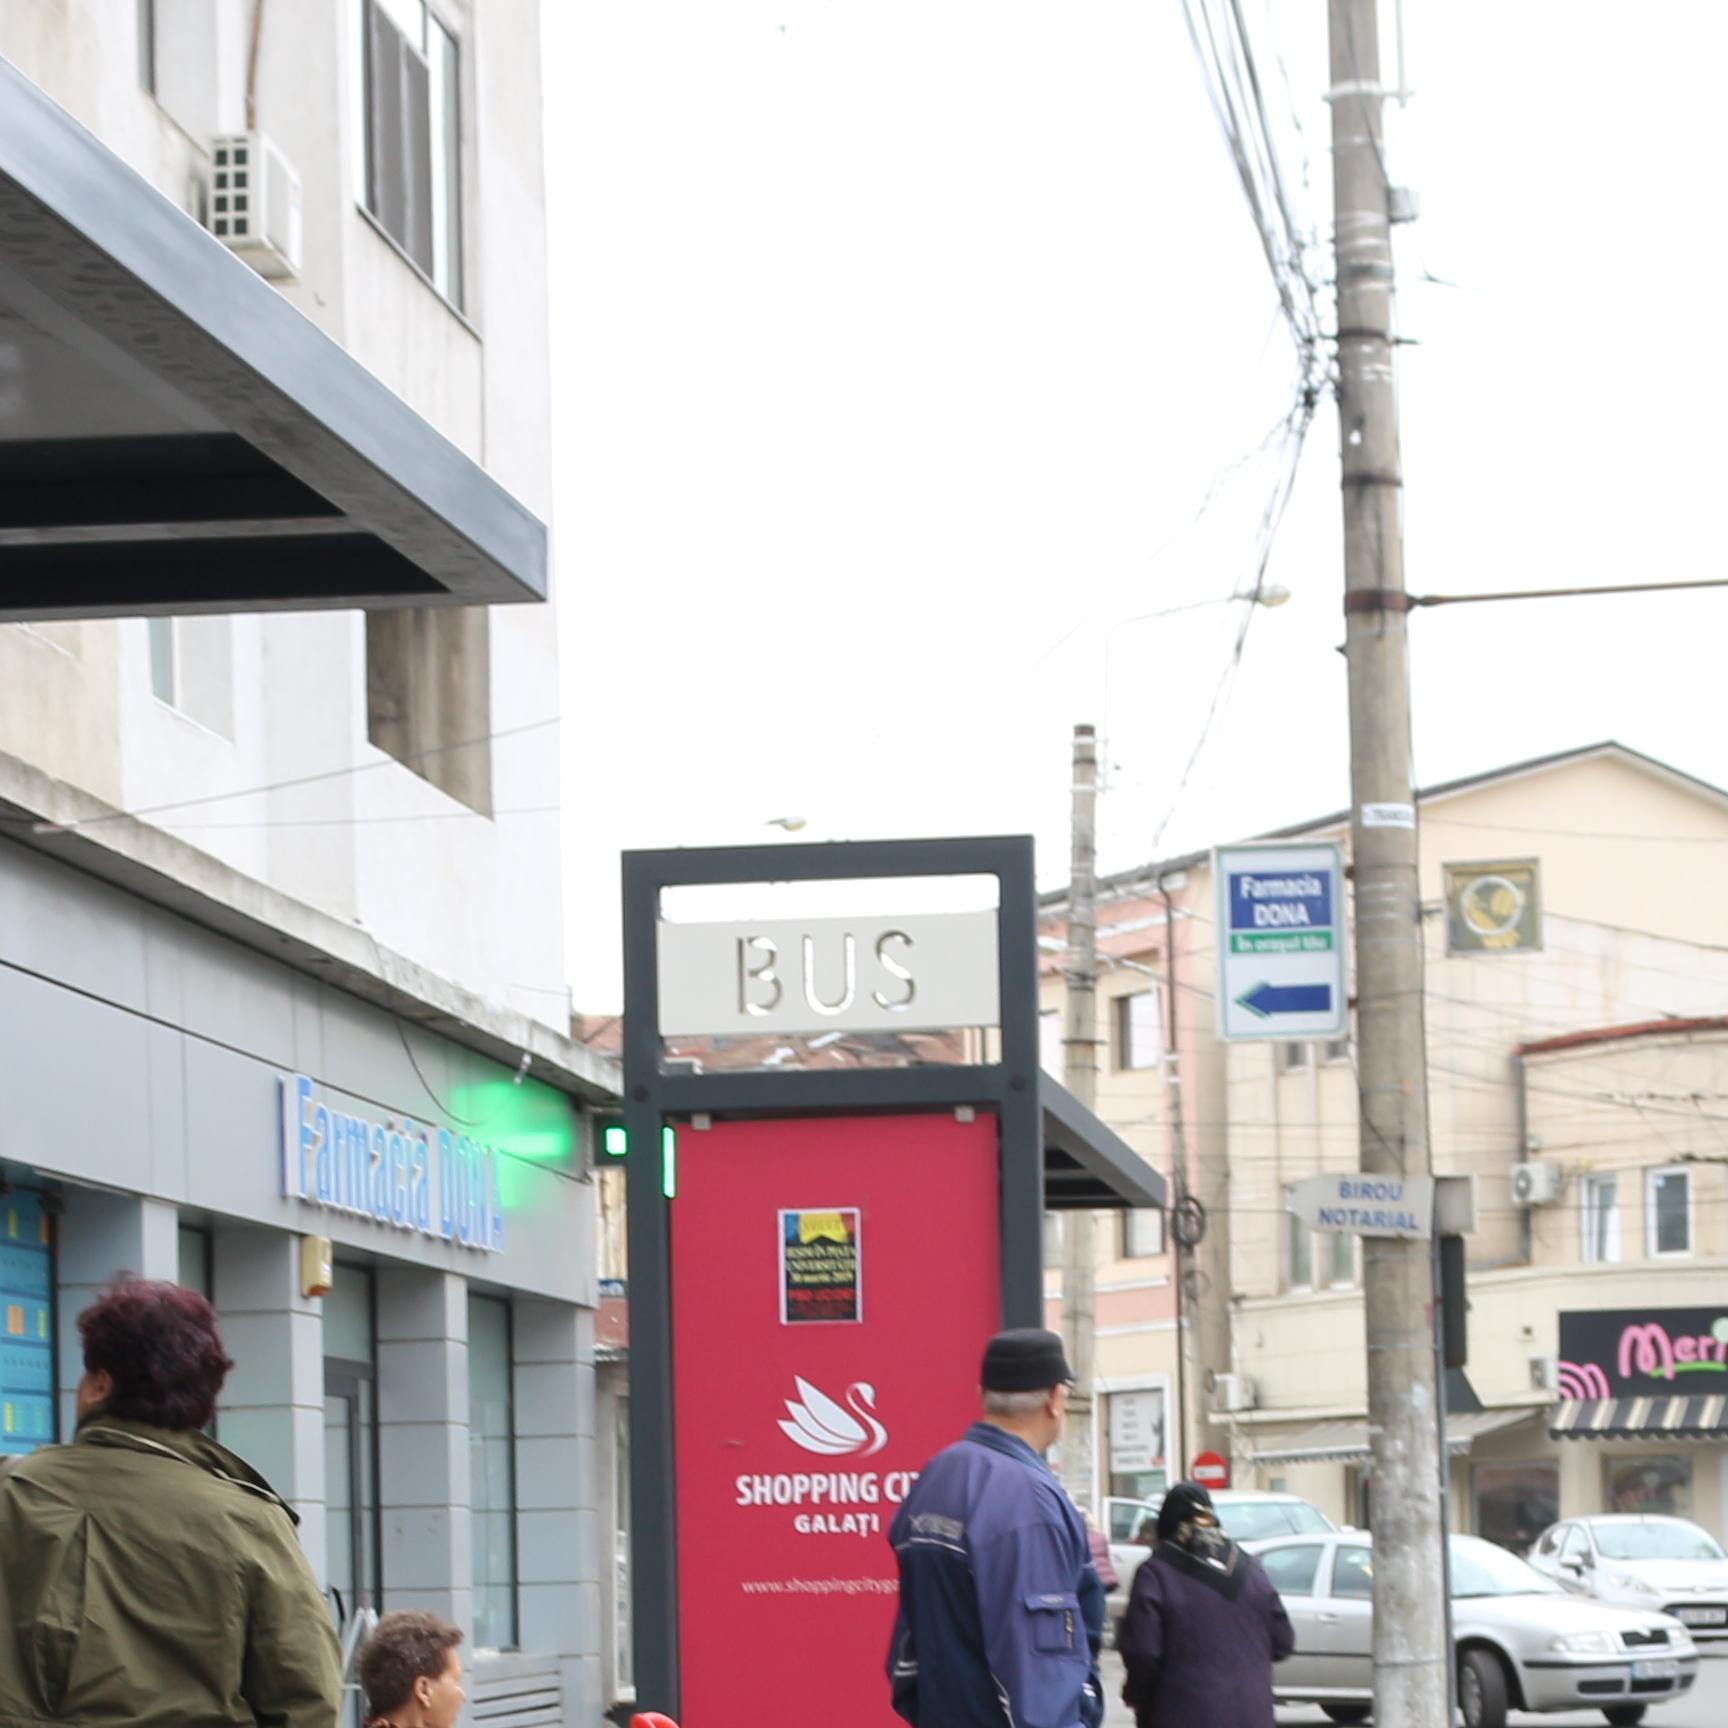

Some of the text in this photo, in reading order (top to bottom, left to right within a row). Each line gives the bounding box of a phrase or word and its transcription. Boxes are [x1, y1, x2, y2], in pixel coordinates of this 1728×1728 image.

[1240, 876, 1321, 898] Farmacia
[1253, 902, 1311, 926] DONA
[736, 930, 915, 1016] BUS
[297, 1074, 507, 1254] Farmacia DONA
[1339, 1181, 1403, 1200] BIROU
[1318, 1207, 1419, 1230] NOTARIAL
[735, 1472, 879, 1505] SHOPPING
